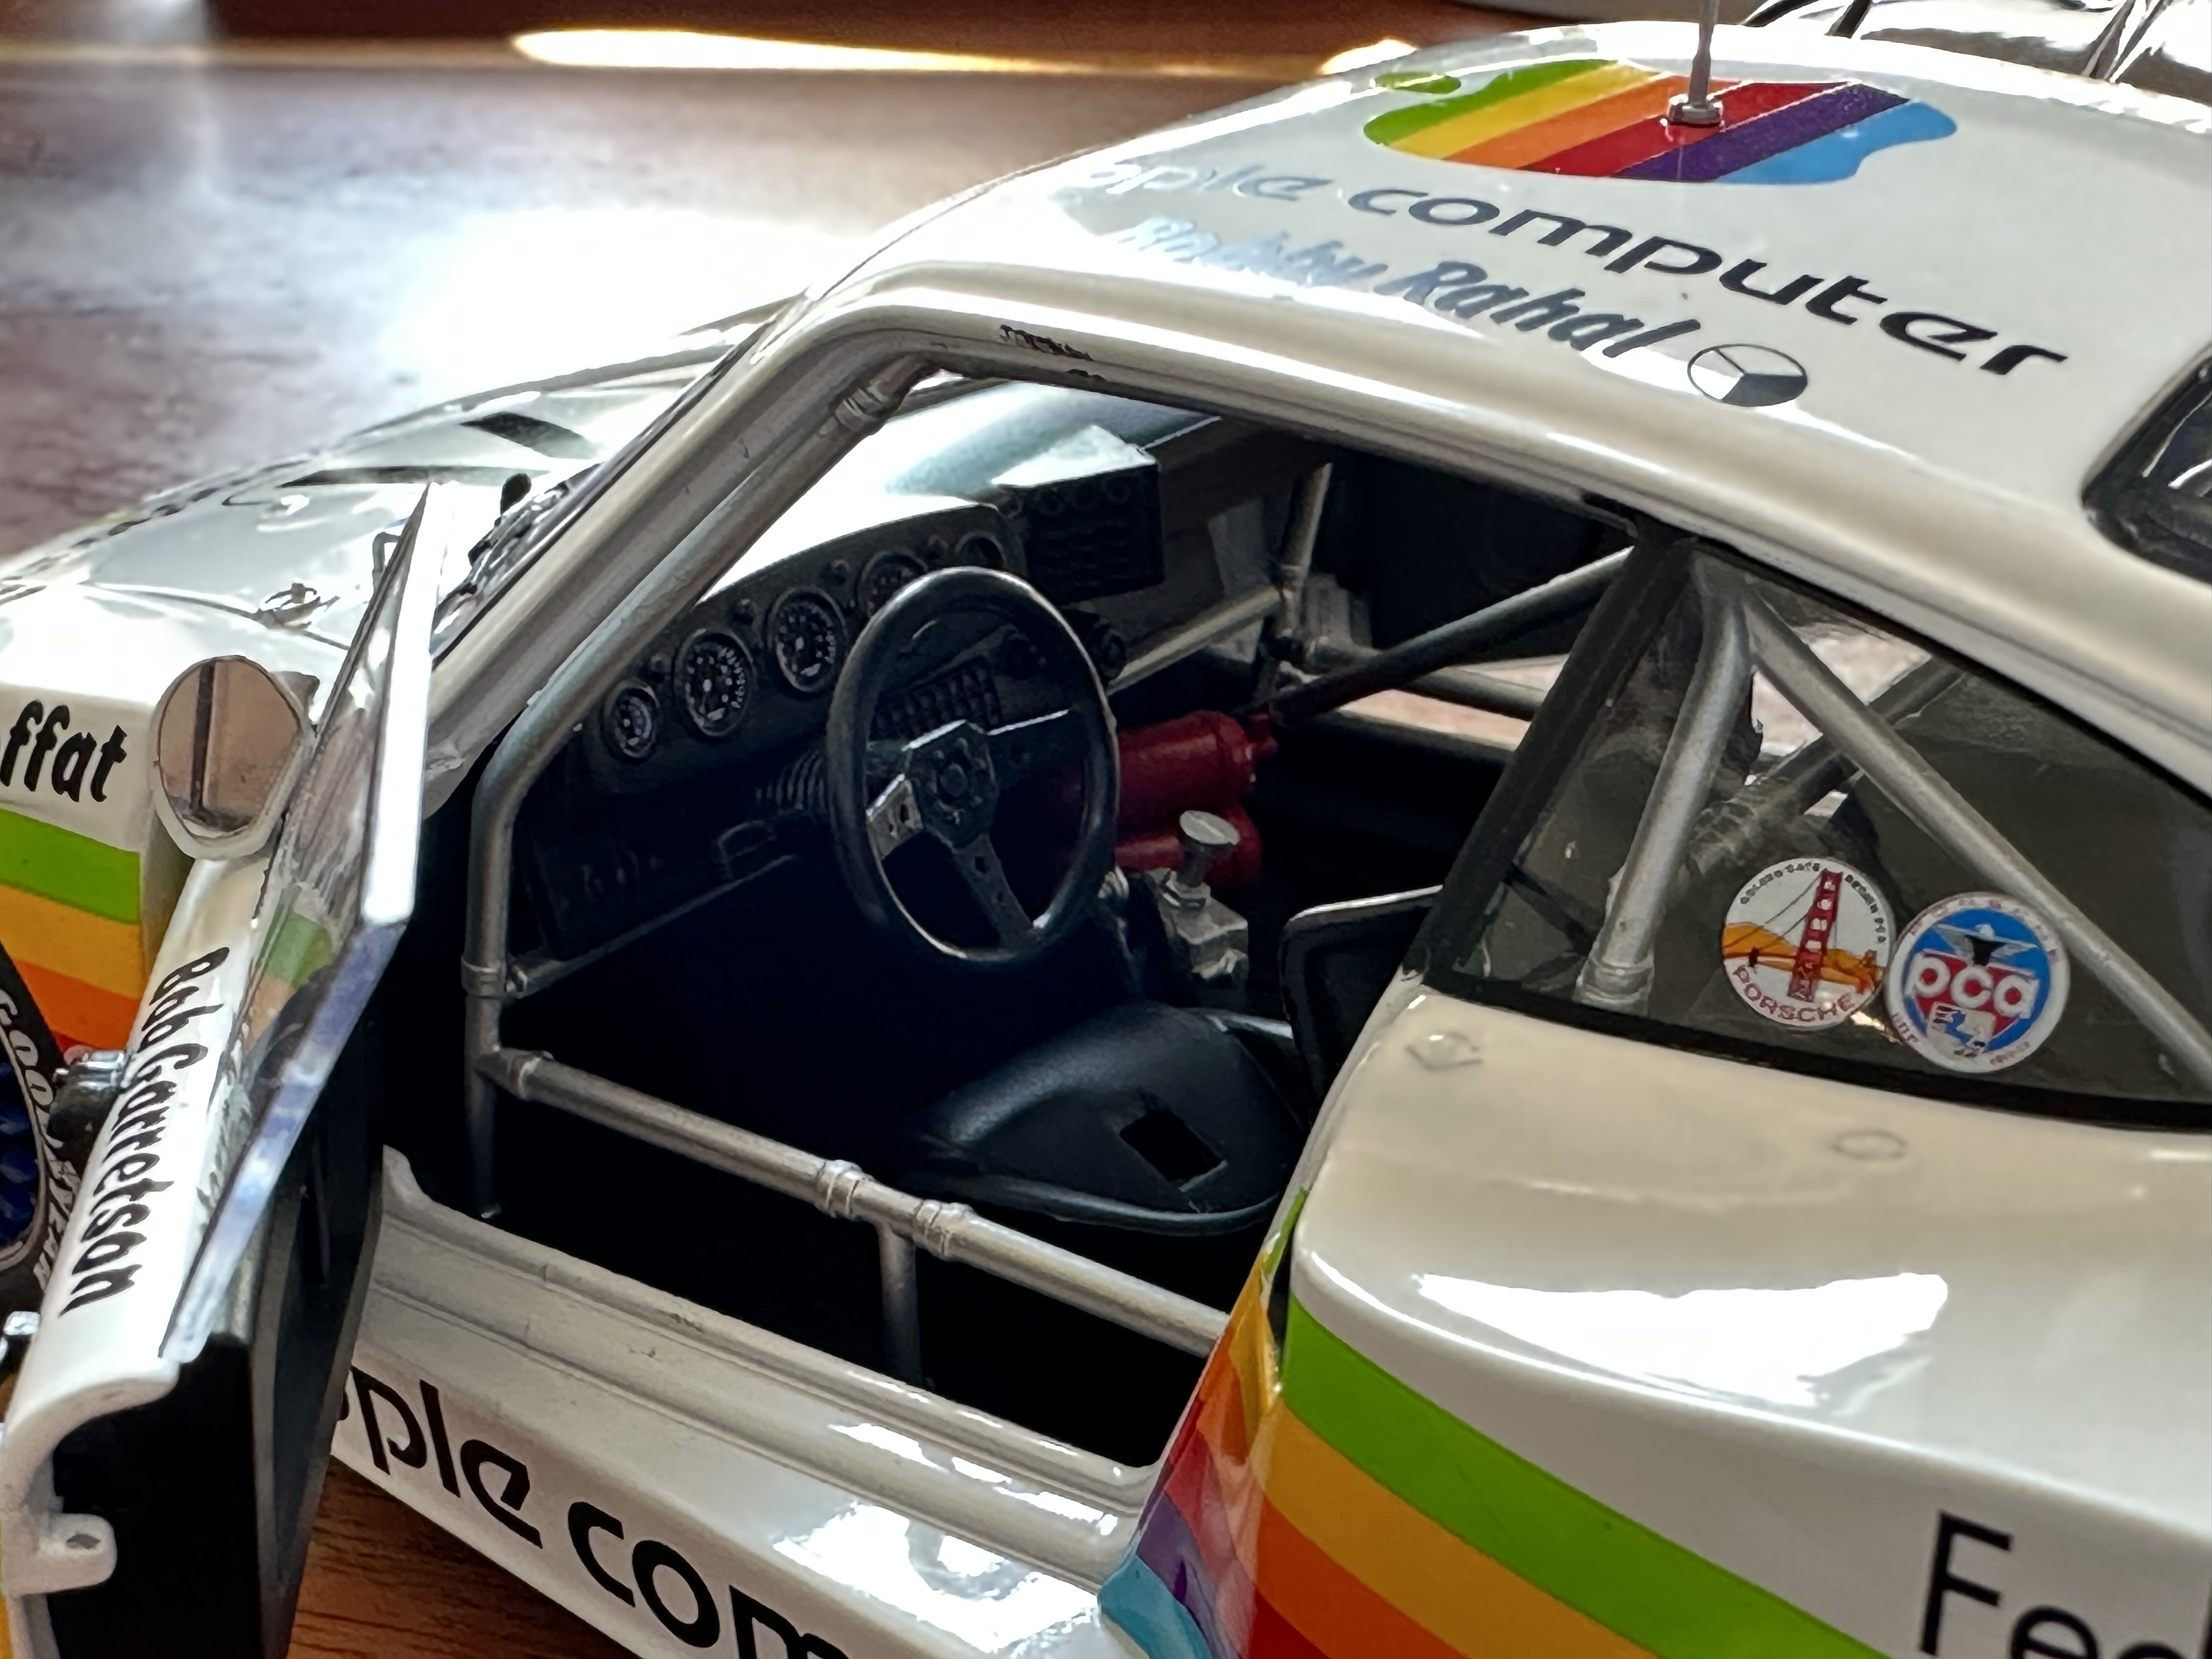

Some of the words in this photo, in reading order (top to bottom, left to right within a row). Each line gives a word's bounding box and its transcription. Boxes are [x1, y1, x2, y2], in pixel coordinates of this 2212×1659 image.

[1347, 188, 2068, 376] computer
[1373, 261, 1701, 358] Rahal
[136, 946, 230, 1054] Bob
[1733, 964, 1855, 1023] PORSCHE
[57, 1043, 208, 1318] Garretson
[338, 1365, 543, 1550] ple
